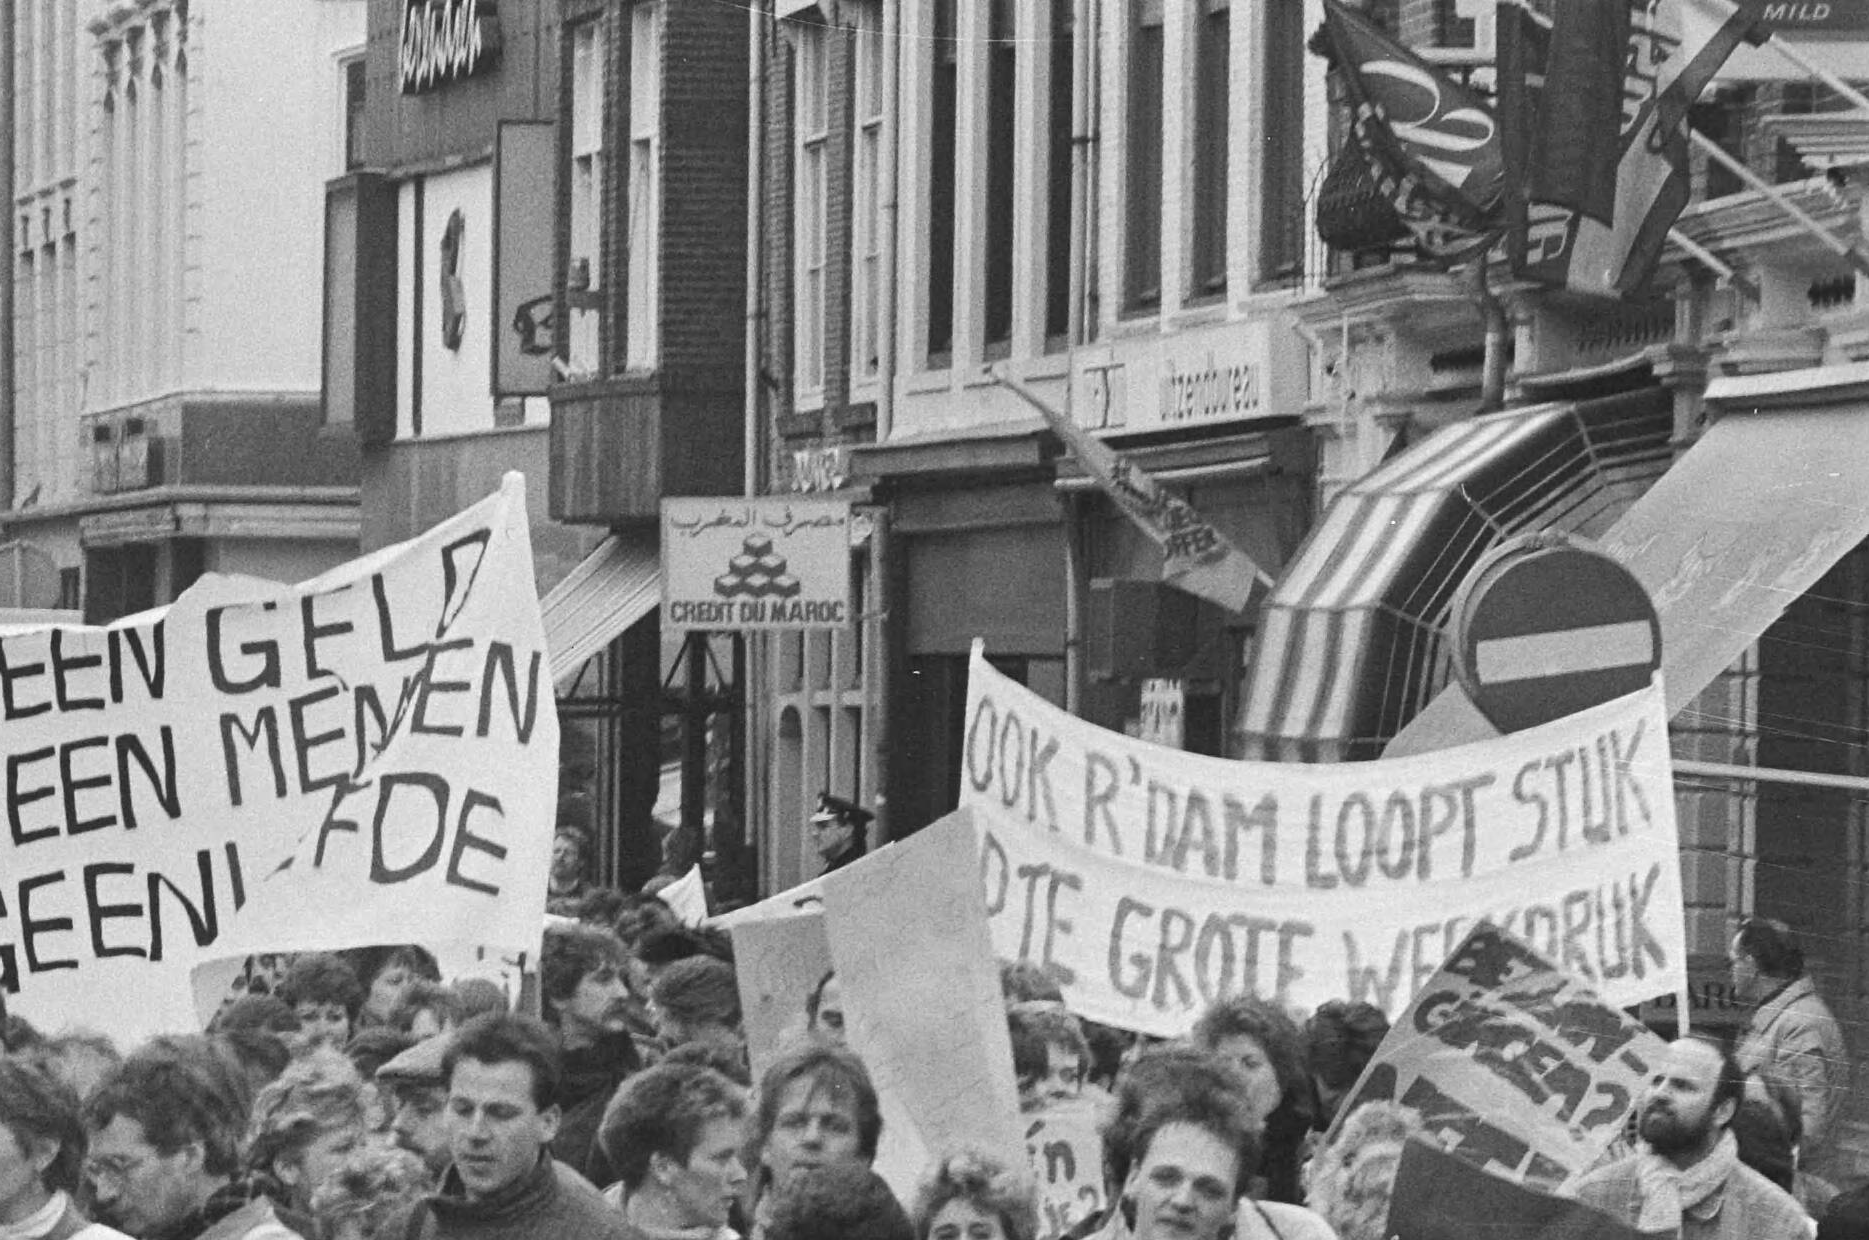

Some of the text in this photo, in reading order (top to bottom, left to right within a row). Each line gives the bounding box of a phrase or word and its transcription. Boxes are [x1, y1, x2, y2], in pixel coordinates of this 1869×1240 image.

[1763, 4, 1832, 21] MILD
[740, 601, 767, 623] DU
[771, 601, 845, 623] MAROC
[967, 694, 1061, 832] OOK
[1083, 752, 1278, 886] R'DAM
[1305, 773, 1497, 890] LOOPT
[1508, 717, 1653, 863] STUK
[1107, 896, 1314, 1010] GROTE
